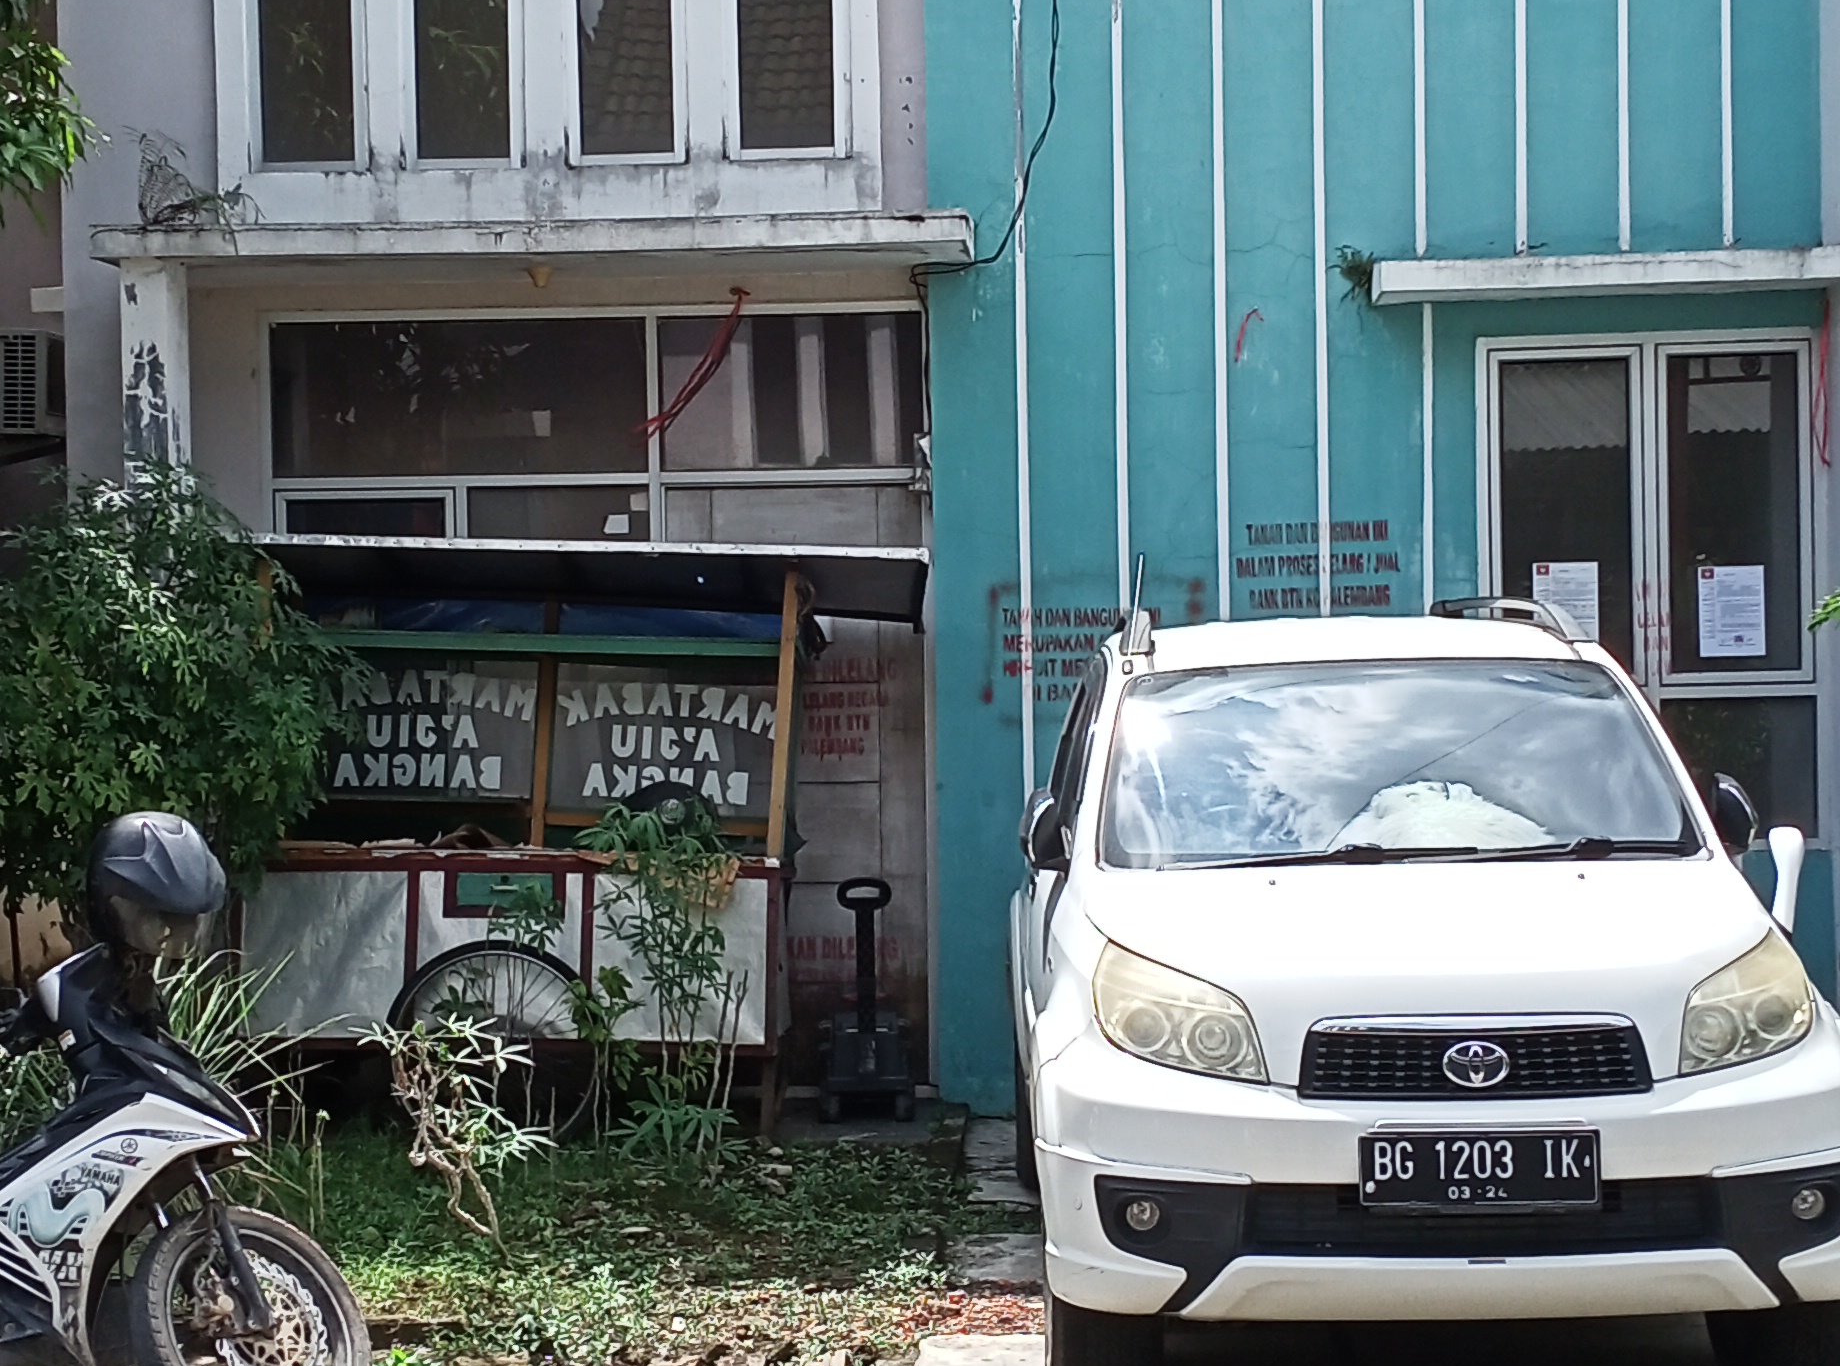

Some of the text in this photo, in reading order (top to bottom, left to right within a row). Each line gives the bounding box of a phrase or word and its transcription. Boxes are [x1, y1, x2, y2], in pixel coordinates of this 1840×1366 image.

[1236, 557, 1276, 579] DALAM
[1374, 551, 1401, 574] JUAL
[1045, 608, 1071, 628] DAN
[821, 935, 900, 961] DILENG
[1373, 1138, 1581, 1181] BG 1203 IK
[80, 1165, 121, 1186] YAMAHA
